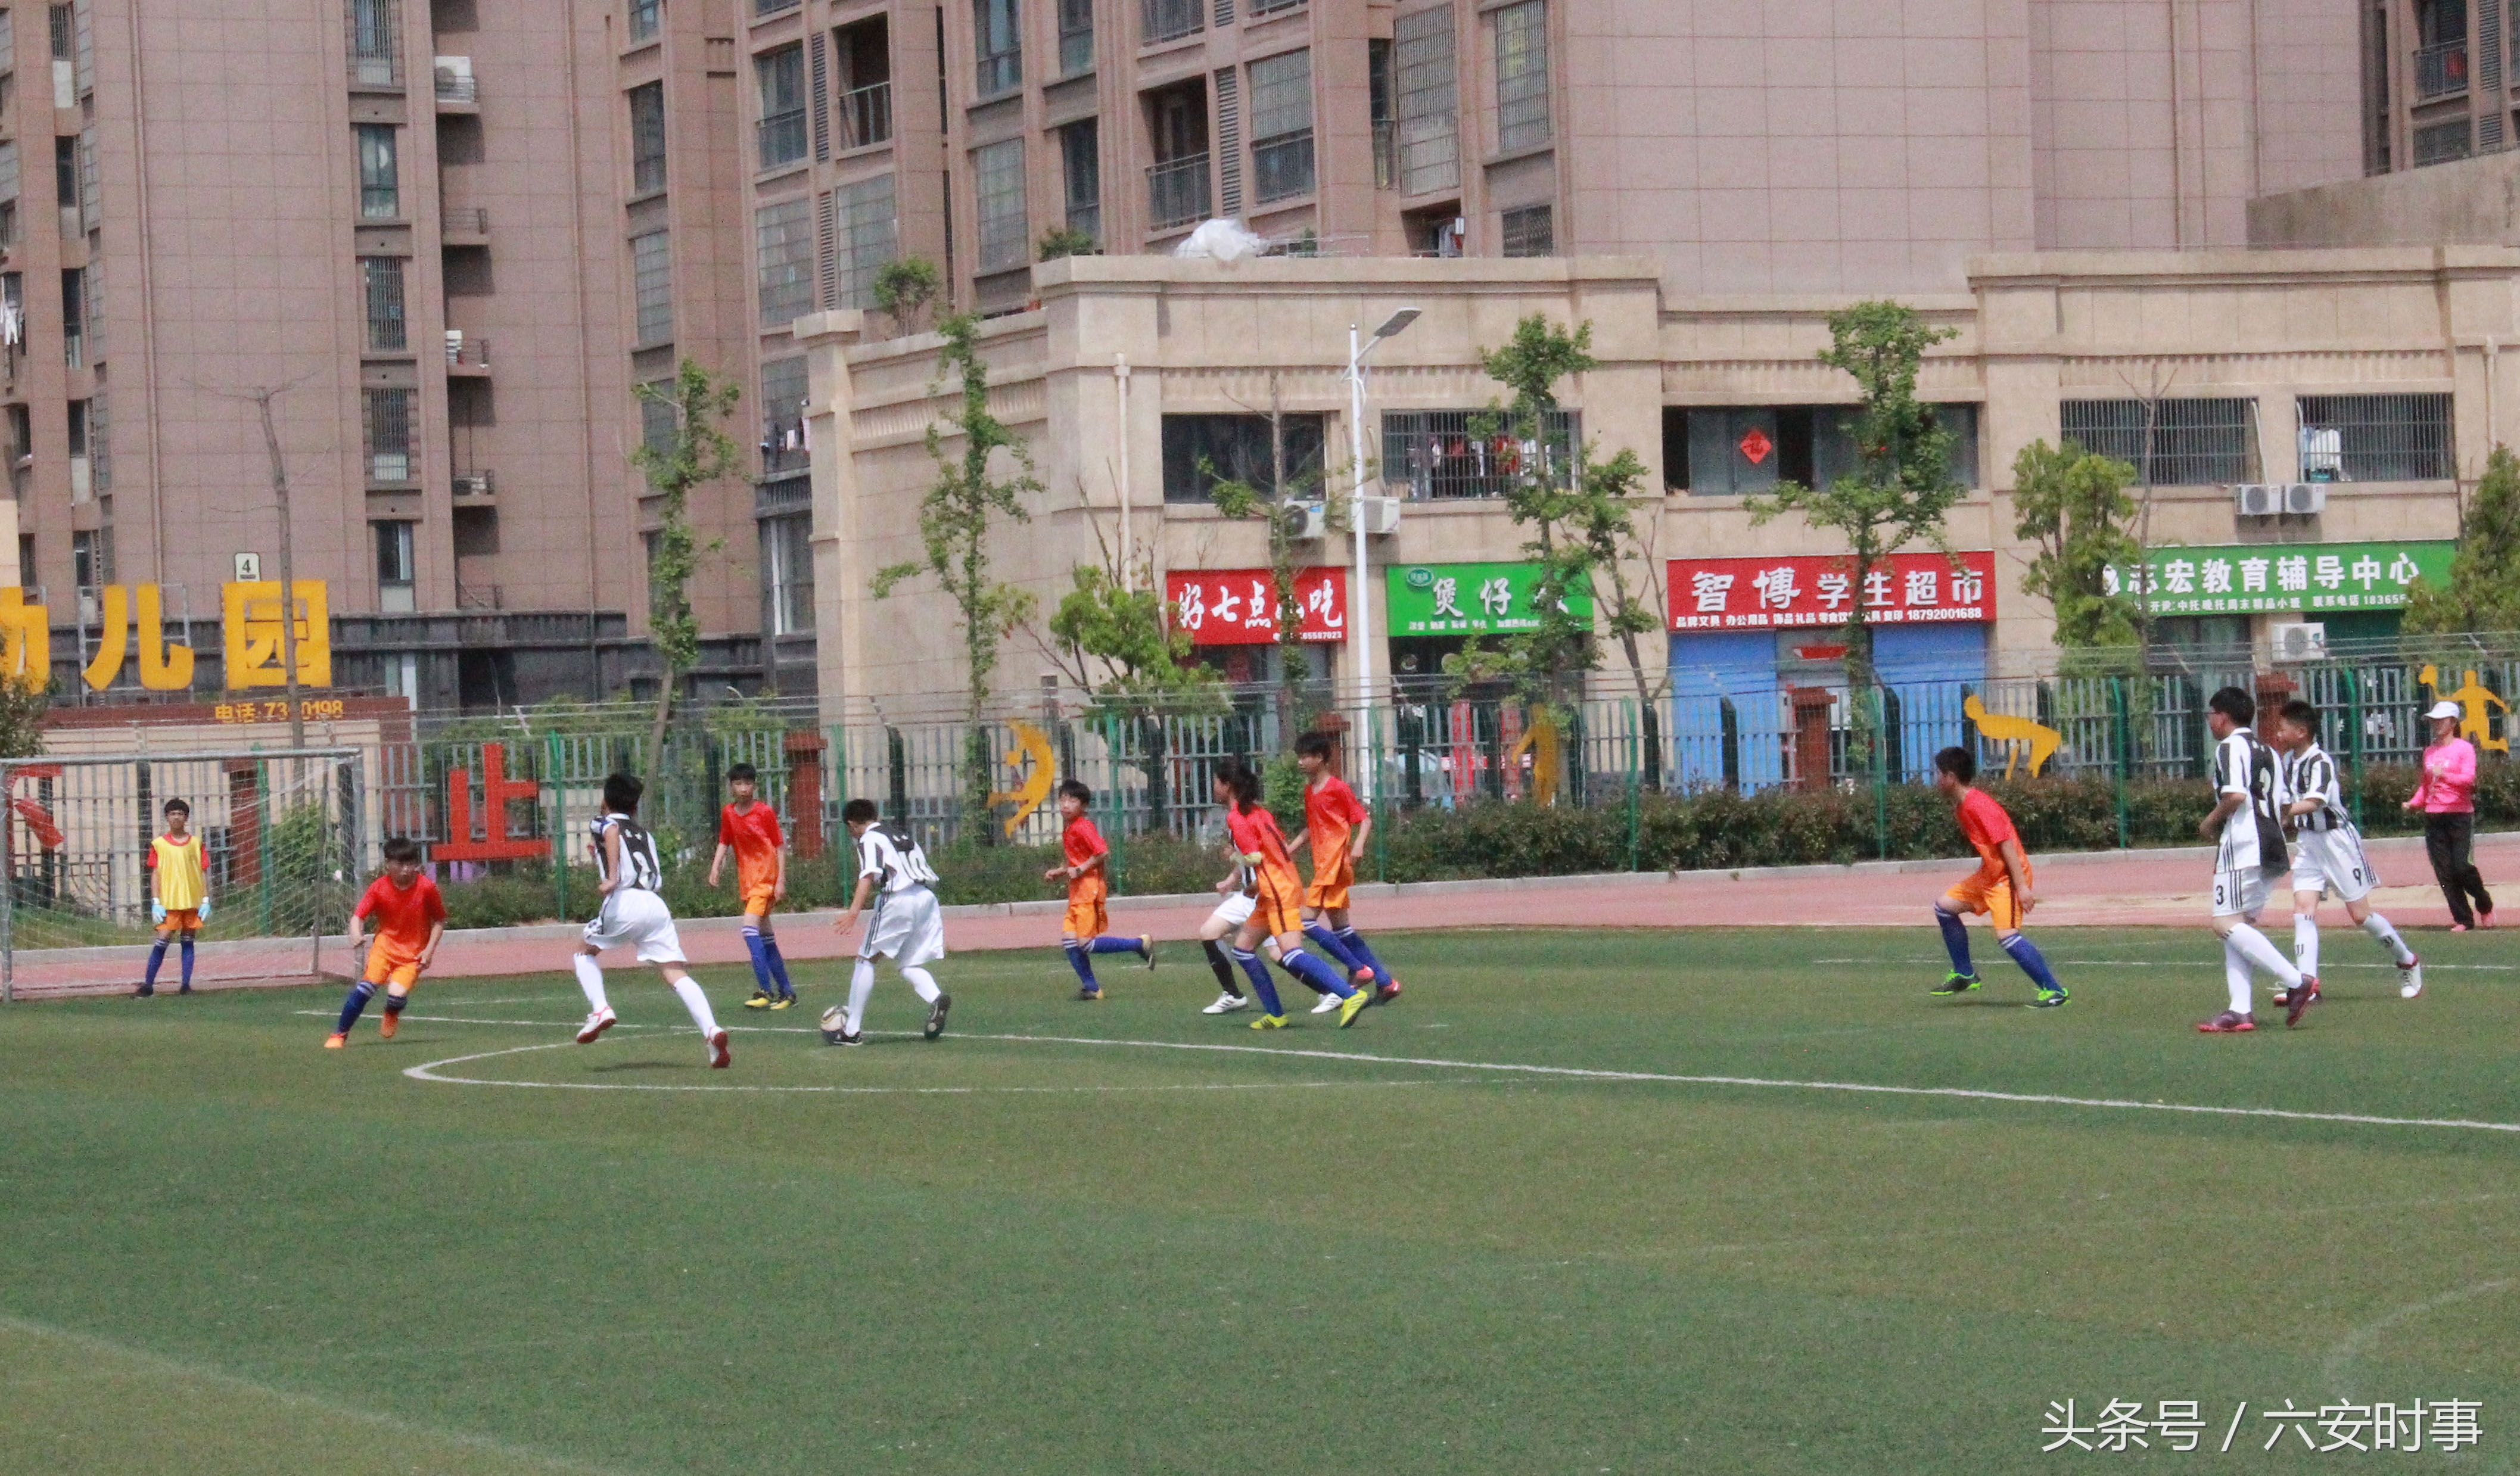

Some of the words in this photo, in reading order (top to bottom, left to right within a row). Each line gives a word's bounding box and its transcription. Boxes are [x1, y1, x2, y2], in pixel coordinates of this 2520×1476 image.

[242, 559, 251, 573] 4
[1433, 577, 1569, 617] 煲仔
[1691, 566, 1983, 612] 智博学生超市
[1726, 614, 1768, 625] 办公用品
[1819, 611, 1853, 623] 零食饮
[1907, 608, 1982, 620] 18792001688
[431, 743, 552, 861] 止
[2353, 868, 2362, 887] 9
[2216, 885, 2224, 905] 3
